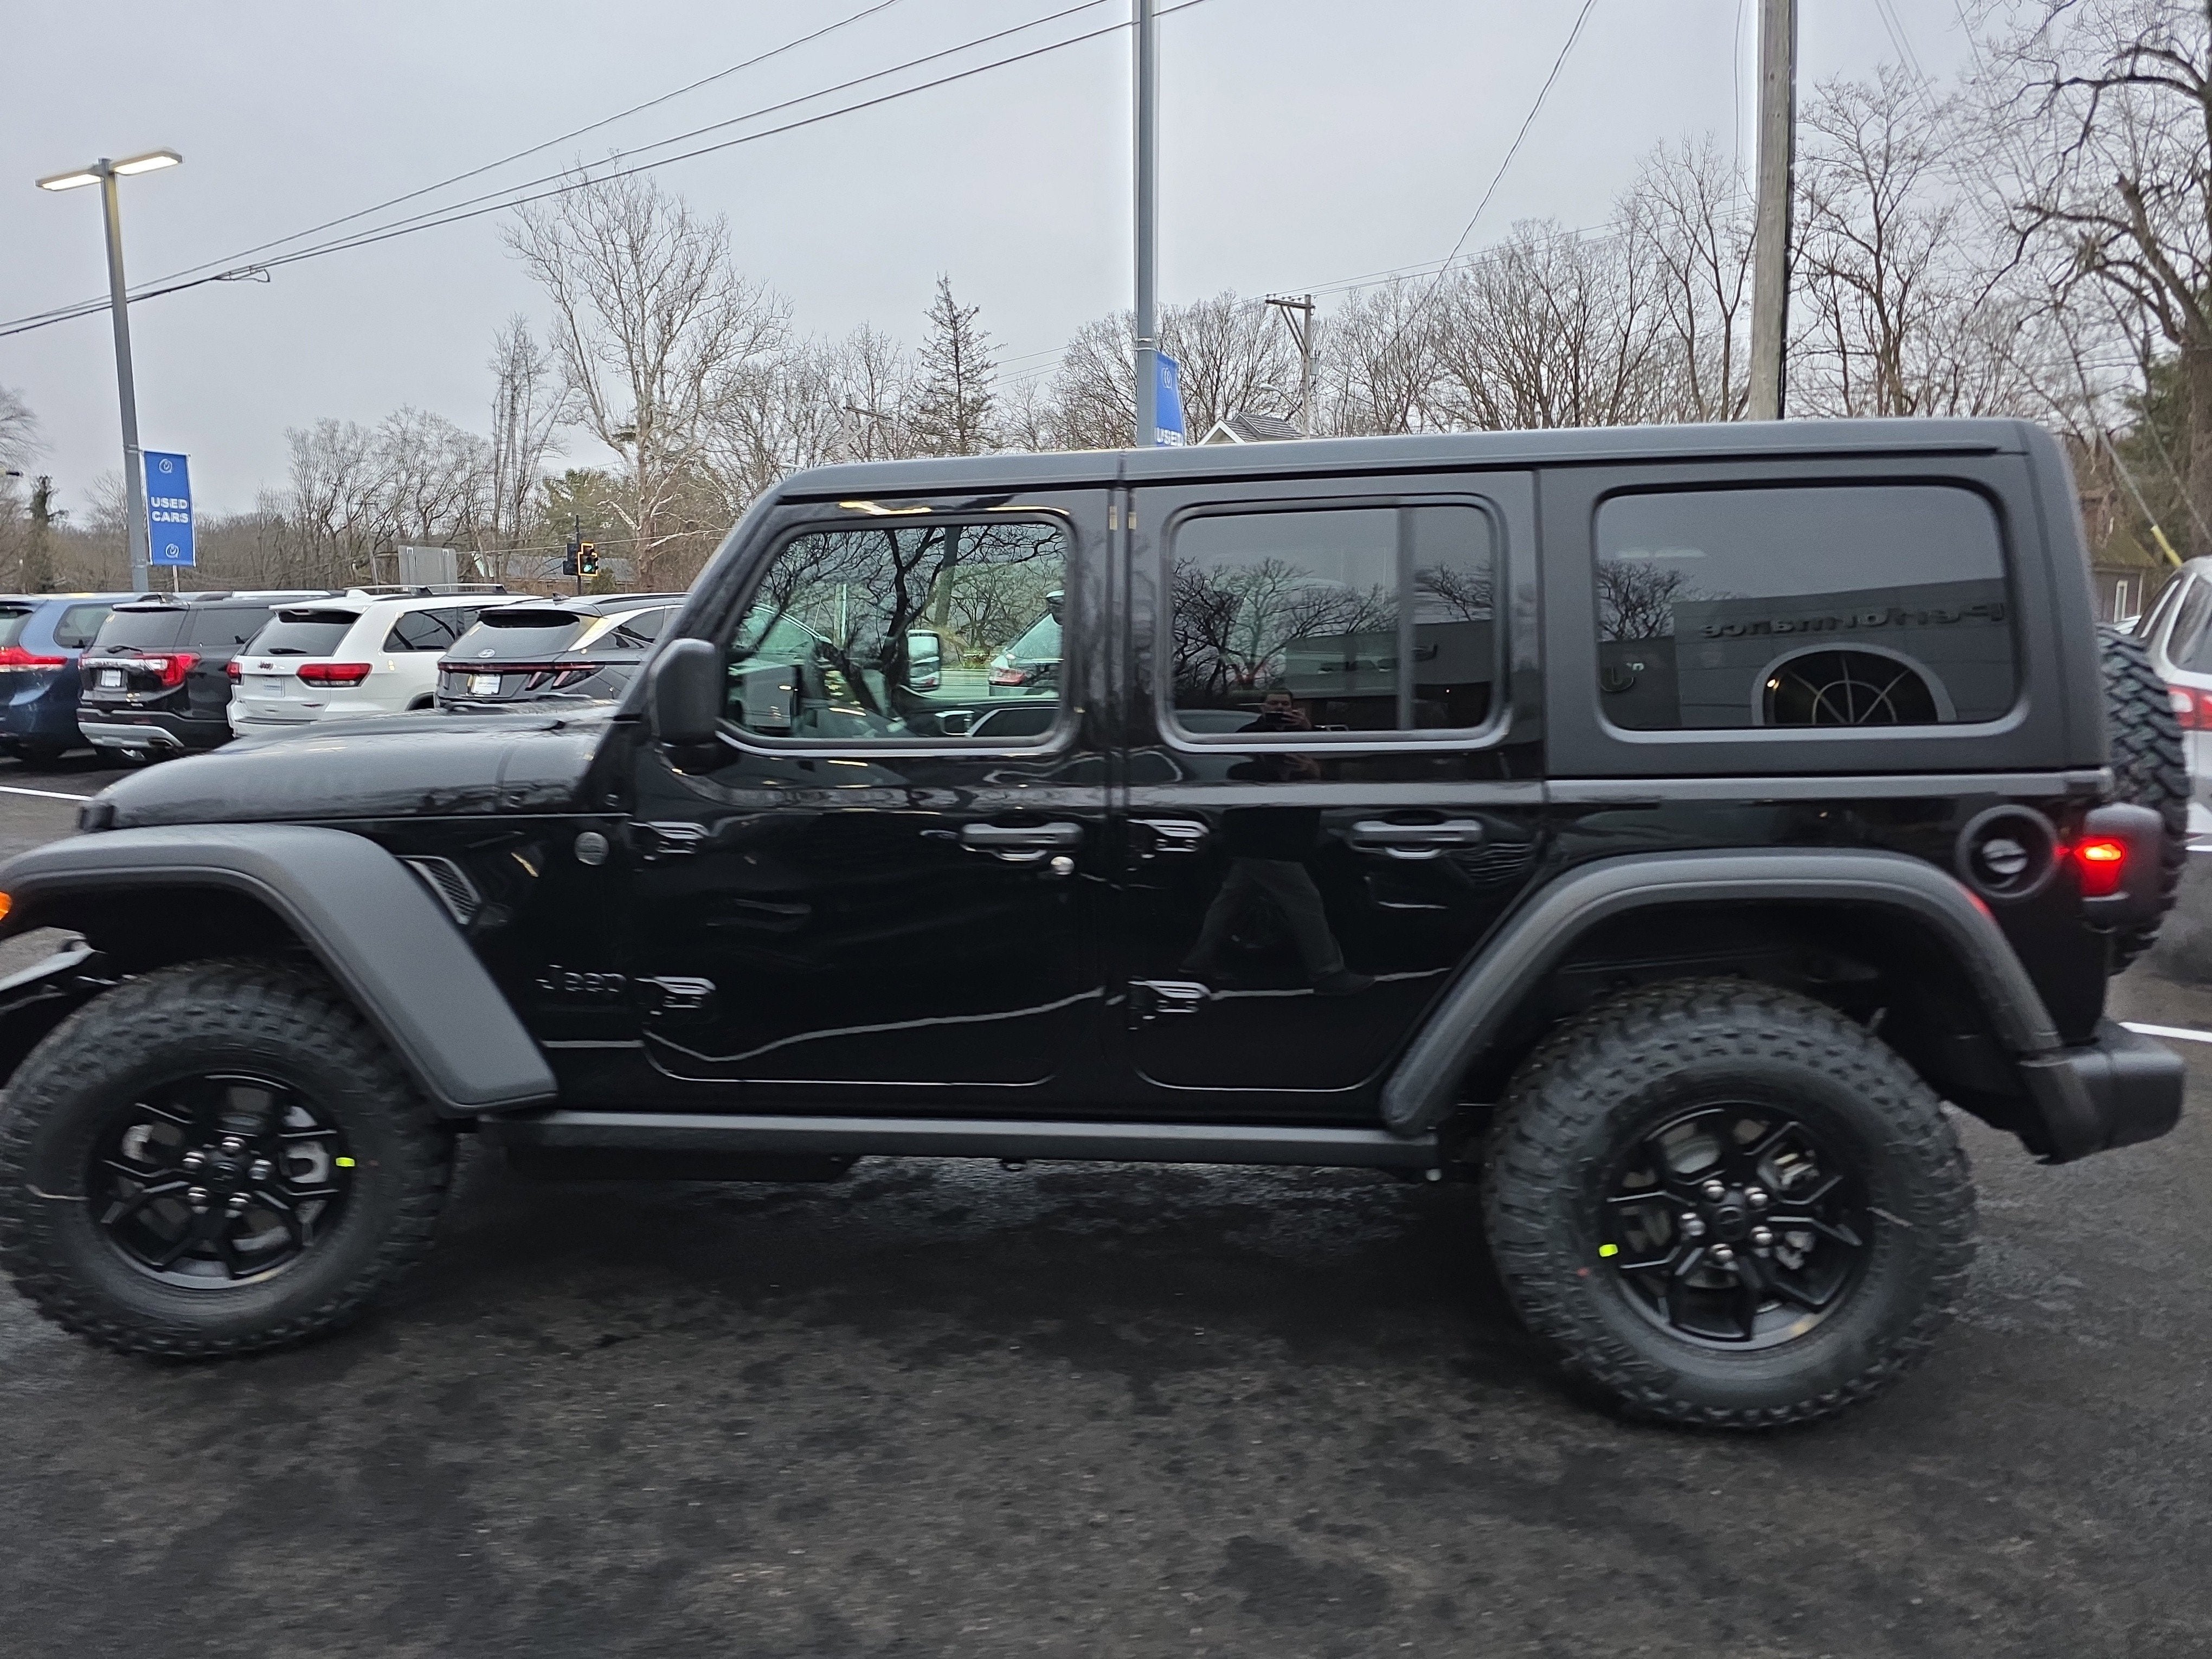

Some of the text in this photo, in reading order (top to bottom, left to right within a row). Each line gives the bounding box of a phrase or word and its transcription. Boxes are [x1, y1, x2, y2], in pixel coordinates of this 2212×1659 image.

[1155, 427, 1184, 446] USED
[150, 496, 188, 510] USED
[151, 510, 189, 524] CARS
[534, 963, 627, 995] Jeep
